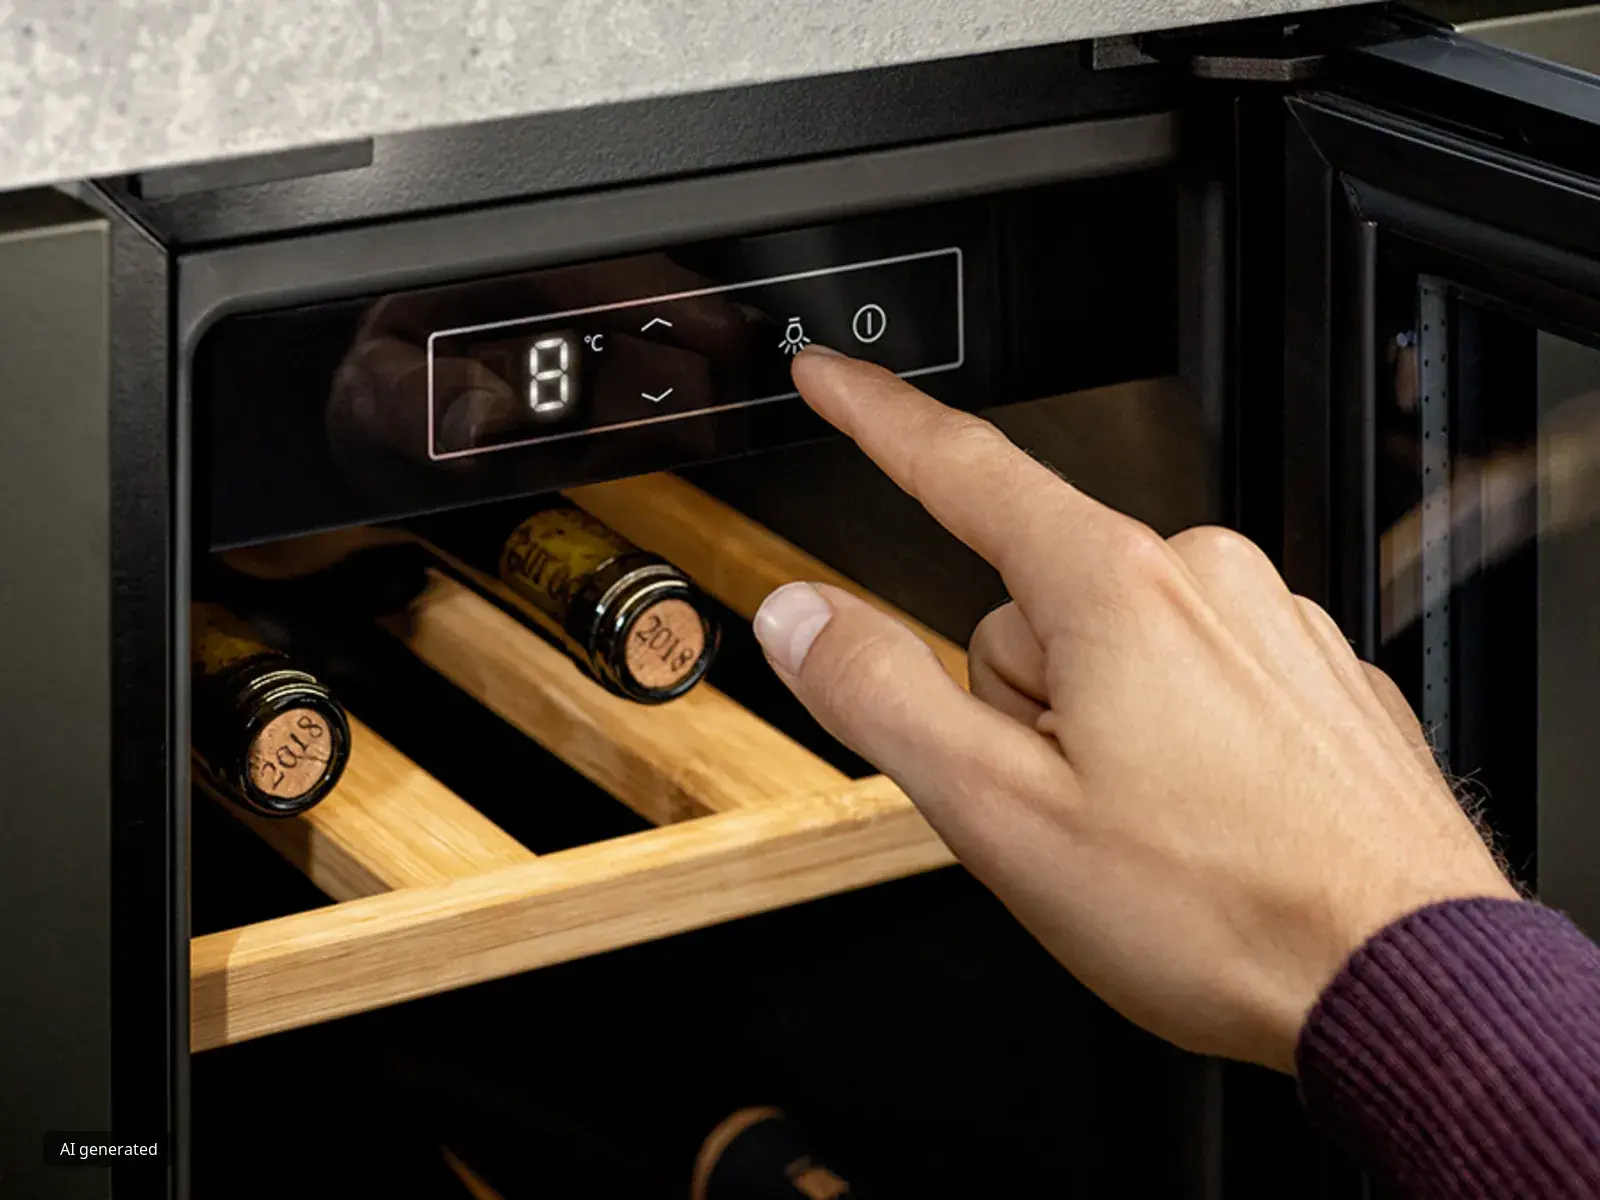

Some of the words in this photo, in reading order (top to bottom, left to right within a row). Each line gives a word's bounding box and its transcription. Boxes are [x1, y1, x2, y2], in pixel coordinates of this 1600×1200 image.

[529, 336, 569, 413] 8
[636, 615, 694, 673] 2018
[260, 715, 324, 790] 2018
